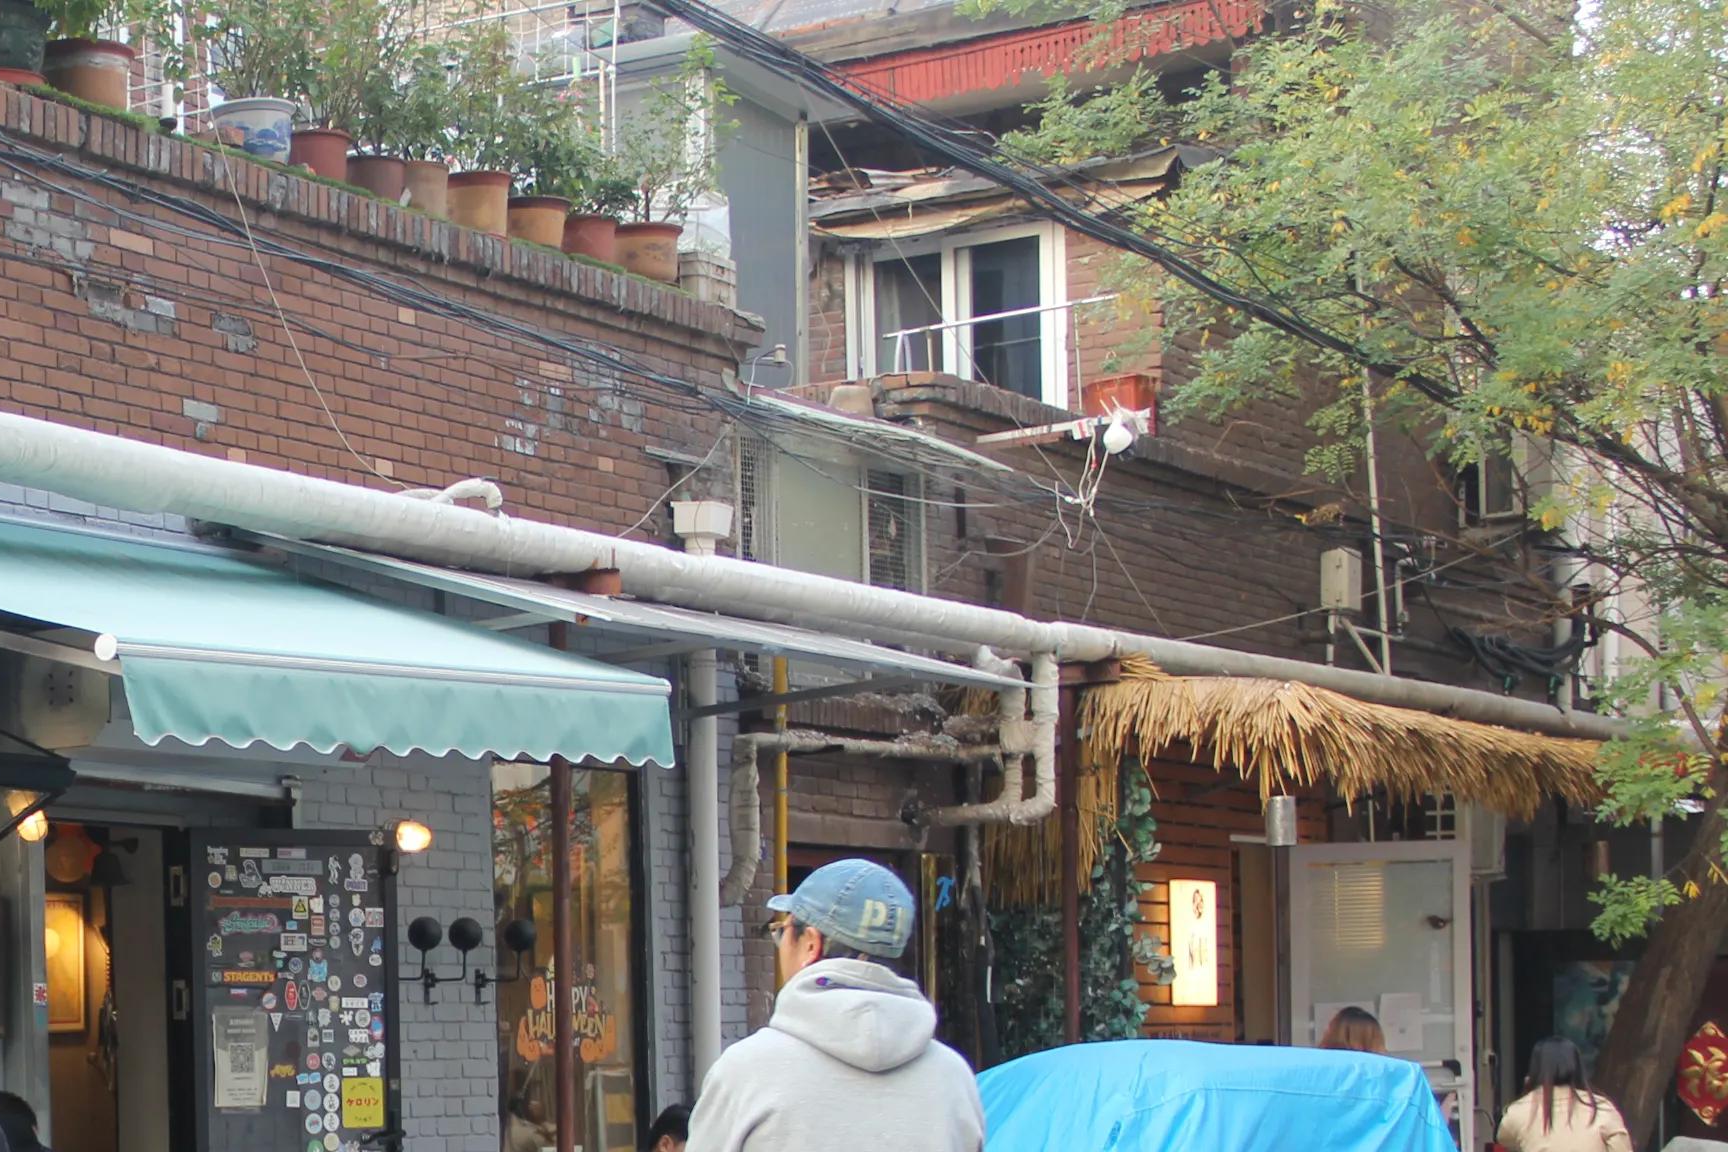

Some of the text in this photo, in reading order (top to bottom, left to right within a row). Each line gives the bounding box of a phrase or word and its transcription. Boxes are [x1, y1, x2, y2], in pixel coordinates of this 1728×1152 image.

[546, 979, 588, 1014] HPY
[527, 1009, 606, 1041] HALWEEN
[345, 1097, 379, 1107] ケロリン
